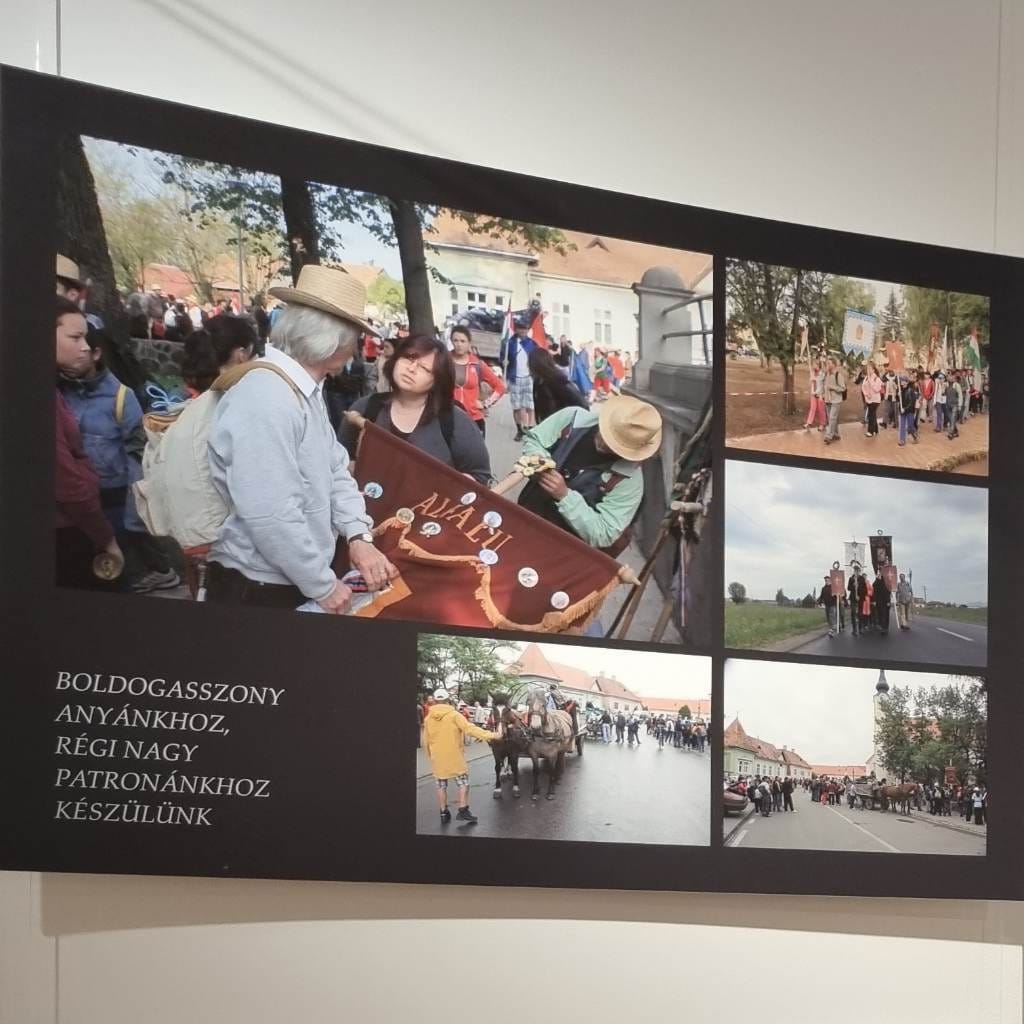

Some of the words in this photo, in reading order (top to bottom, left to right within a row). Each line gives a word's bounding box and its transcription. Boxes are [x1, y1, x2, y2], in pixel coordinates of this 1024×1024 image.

[56, 671, 285, 706] BOLDOGASSZONY
[54, 703, 230, 736] ANYÁNKHOZ,
[55, 732, 118, 758] RÉGI
[123, 741, 199, 762] NAGY
[55, 769, 271, 798] PATRONÁNKHOZ
[55, 797, 212, 826] KÉSZÜLÜNK
